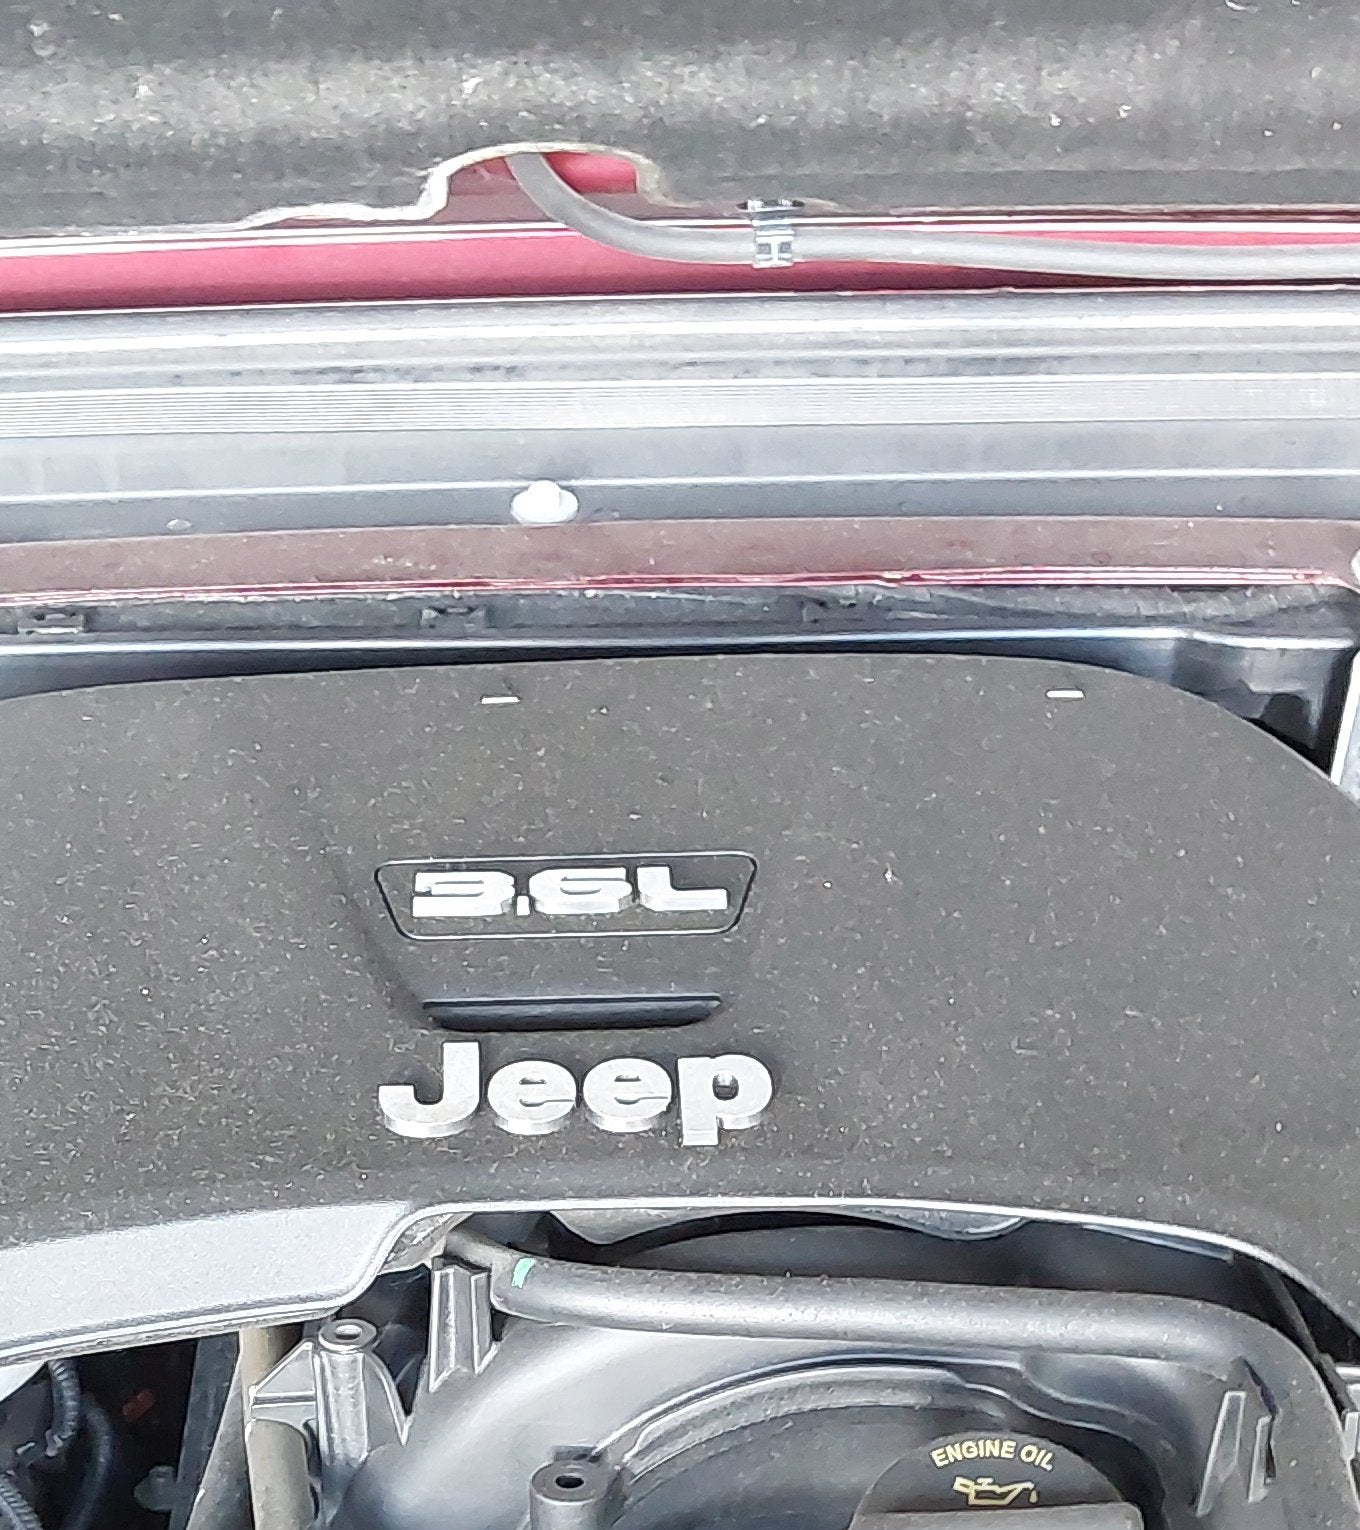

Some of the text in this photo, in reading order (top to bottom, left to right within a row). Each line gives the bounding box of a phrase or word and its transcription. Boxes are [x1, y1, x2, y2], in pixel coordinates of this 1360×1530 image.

[412, 865, 729, 918] 3.6L
[377, 1040, 773, 1147] Jeep
[930, 1438, 1054, 1472] ENGINE OIL
